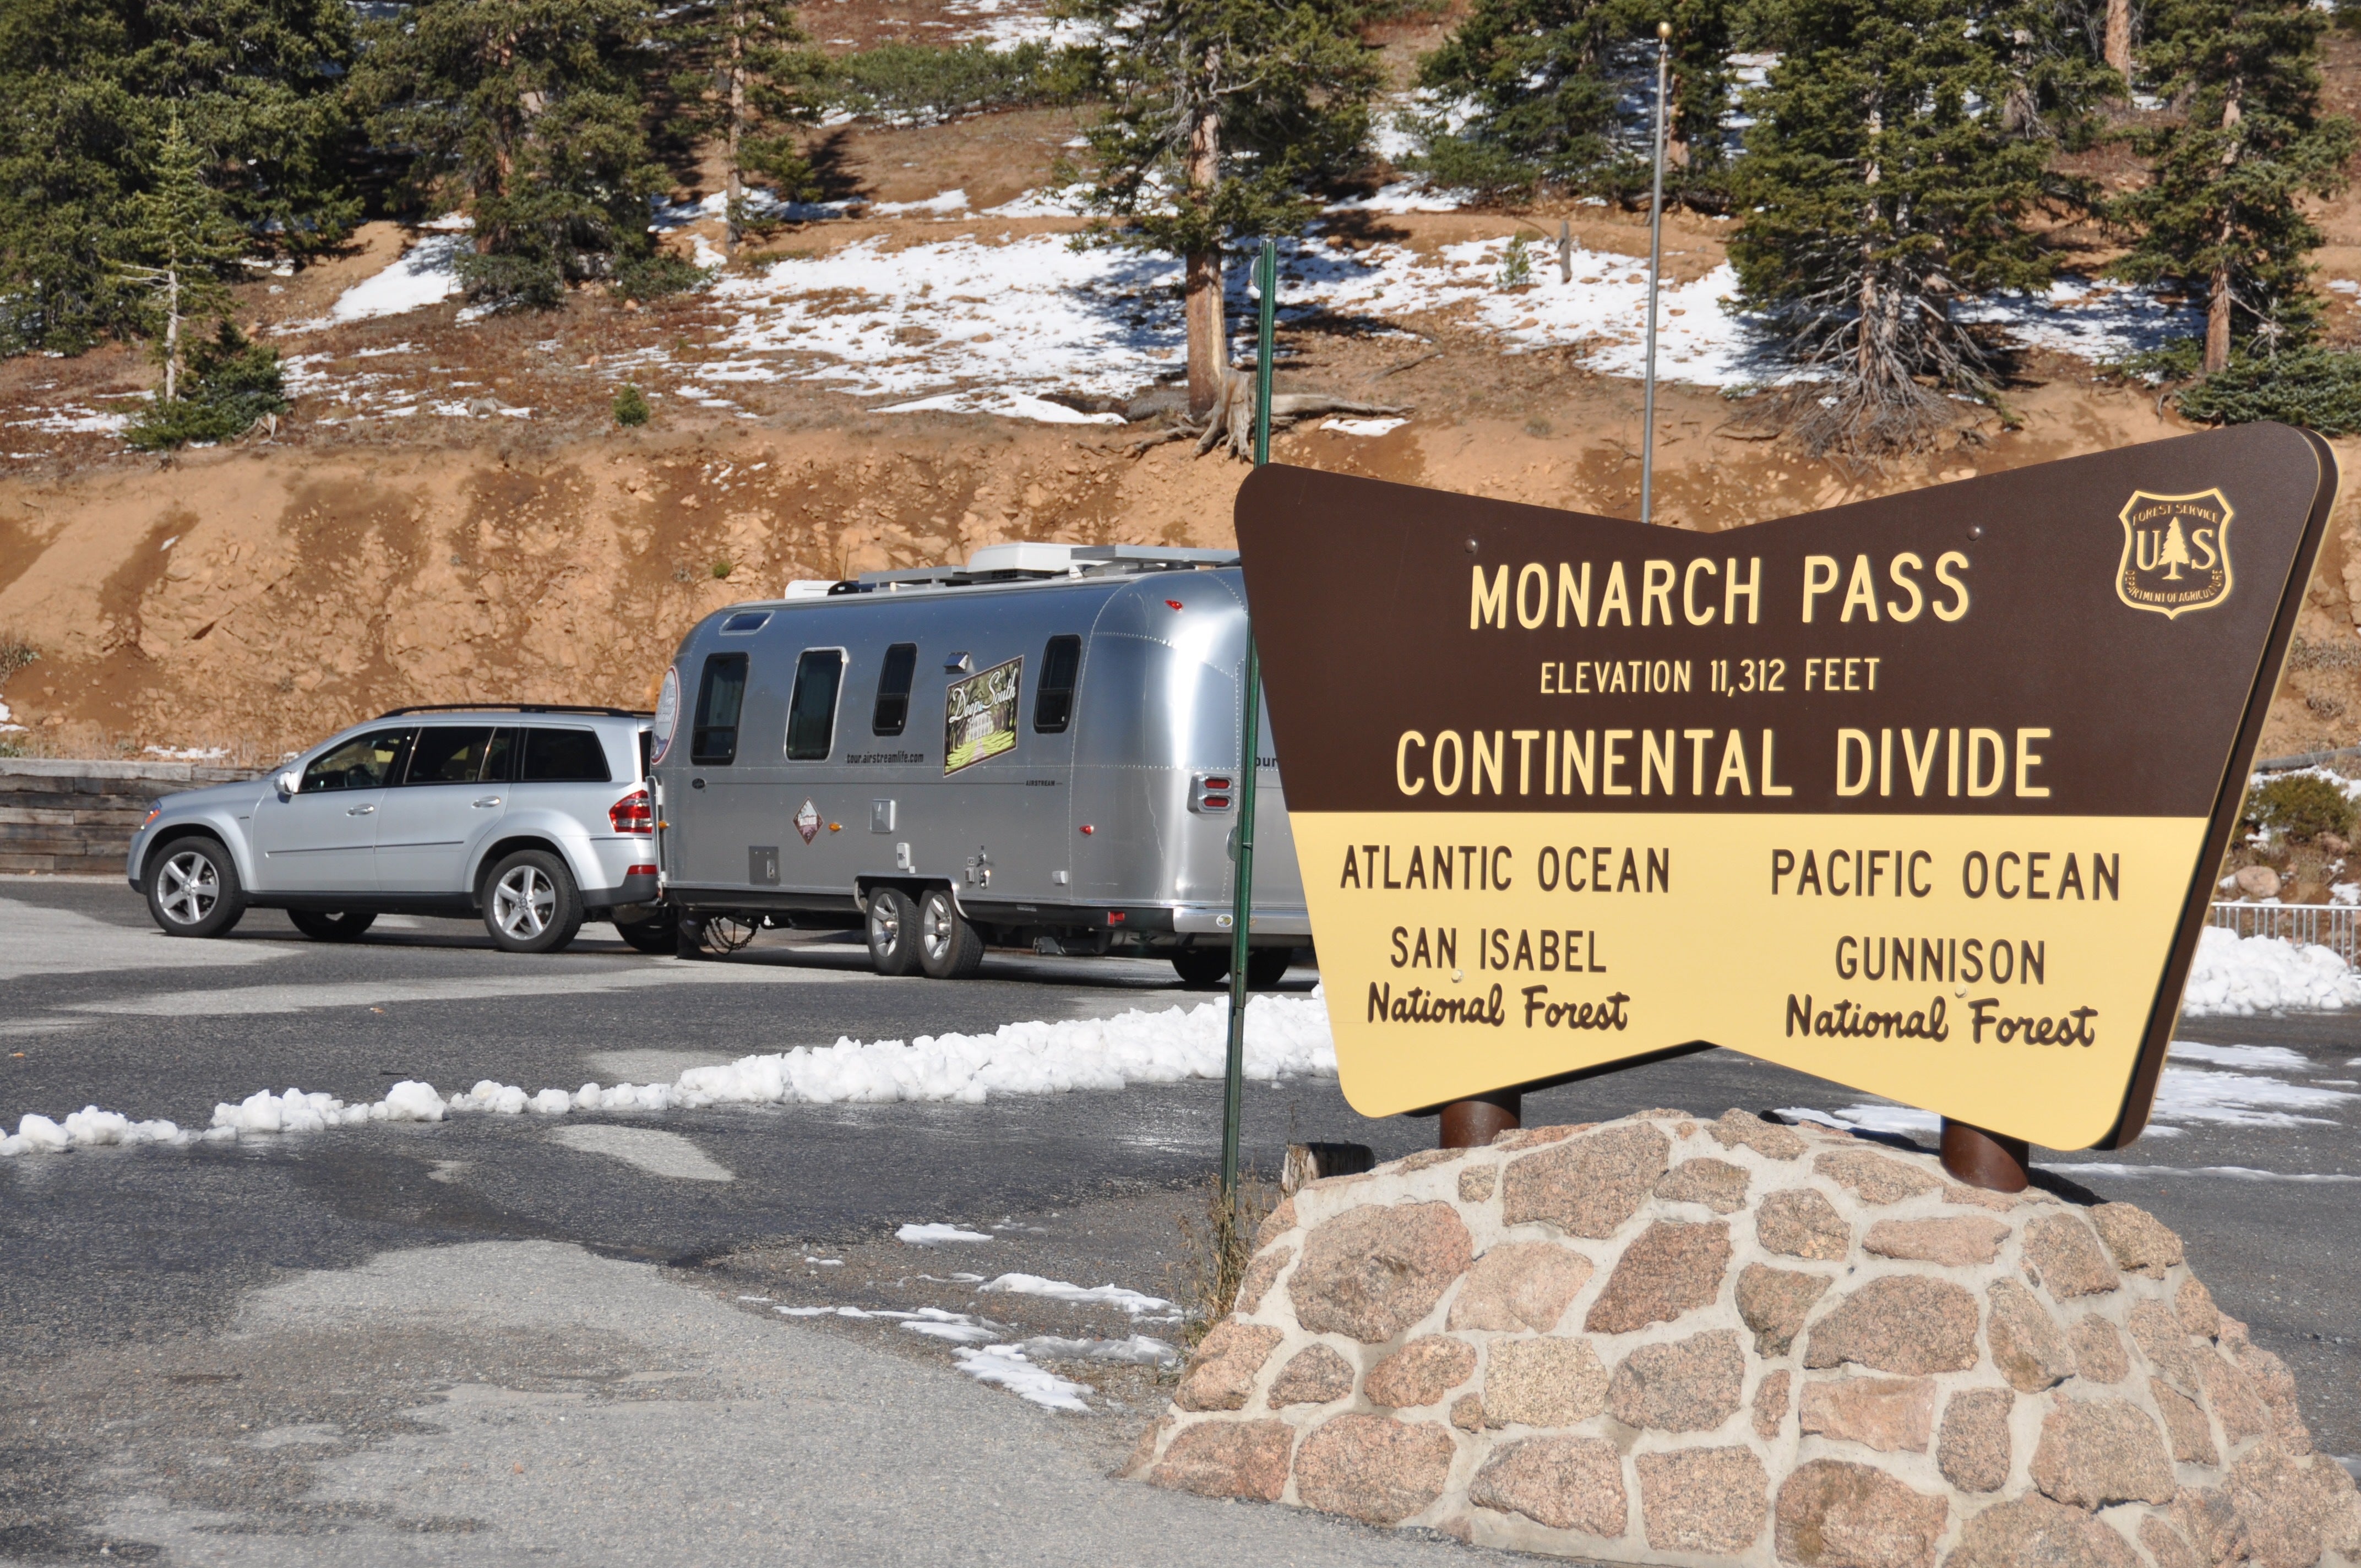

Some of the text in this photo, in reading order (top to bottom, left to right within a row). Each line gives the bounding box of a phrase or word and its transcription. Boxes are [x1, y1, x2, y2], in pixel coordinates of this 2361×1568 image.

[2132, 504, 2218, 526] FOREST SERVICE
[1471, 551, 1969, 630] MONARCH PASS
[2167, 593, 2177, 603] OF
[949, 668, 1017, 725] Deep South
[1541, 658, 1880, 697] ELEVATION 11,312 FEET
[847, 751, 923, 764] tour.airstreamlife.com
[1256, 757, 1277, 767] our
[1396, 728, 2051, 797] CONTINENTAL DIVIDE
[1340, 845, 1669, 893] ATLANTIC OCEAN
[1772, 849, 2119, 901] PACIFIC OCEAN
[1390, 926, 1607, 973] SAN ISABEL
[1836, 935, 2044, 985] GUNNISON
[1368, 982, 1630, 1031] National Forest
[1786, 994, 2098, 1048] National Forest
